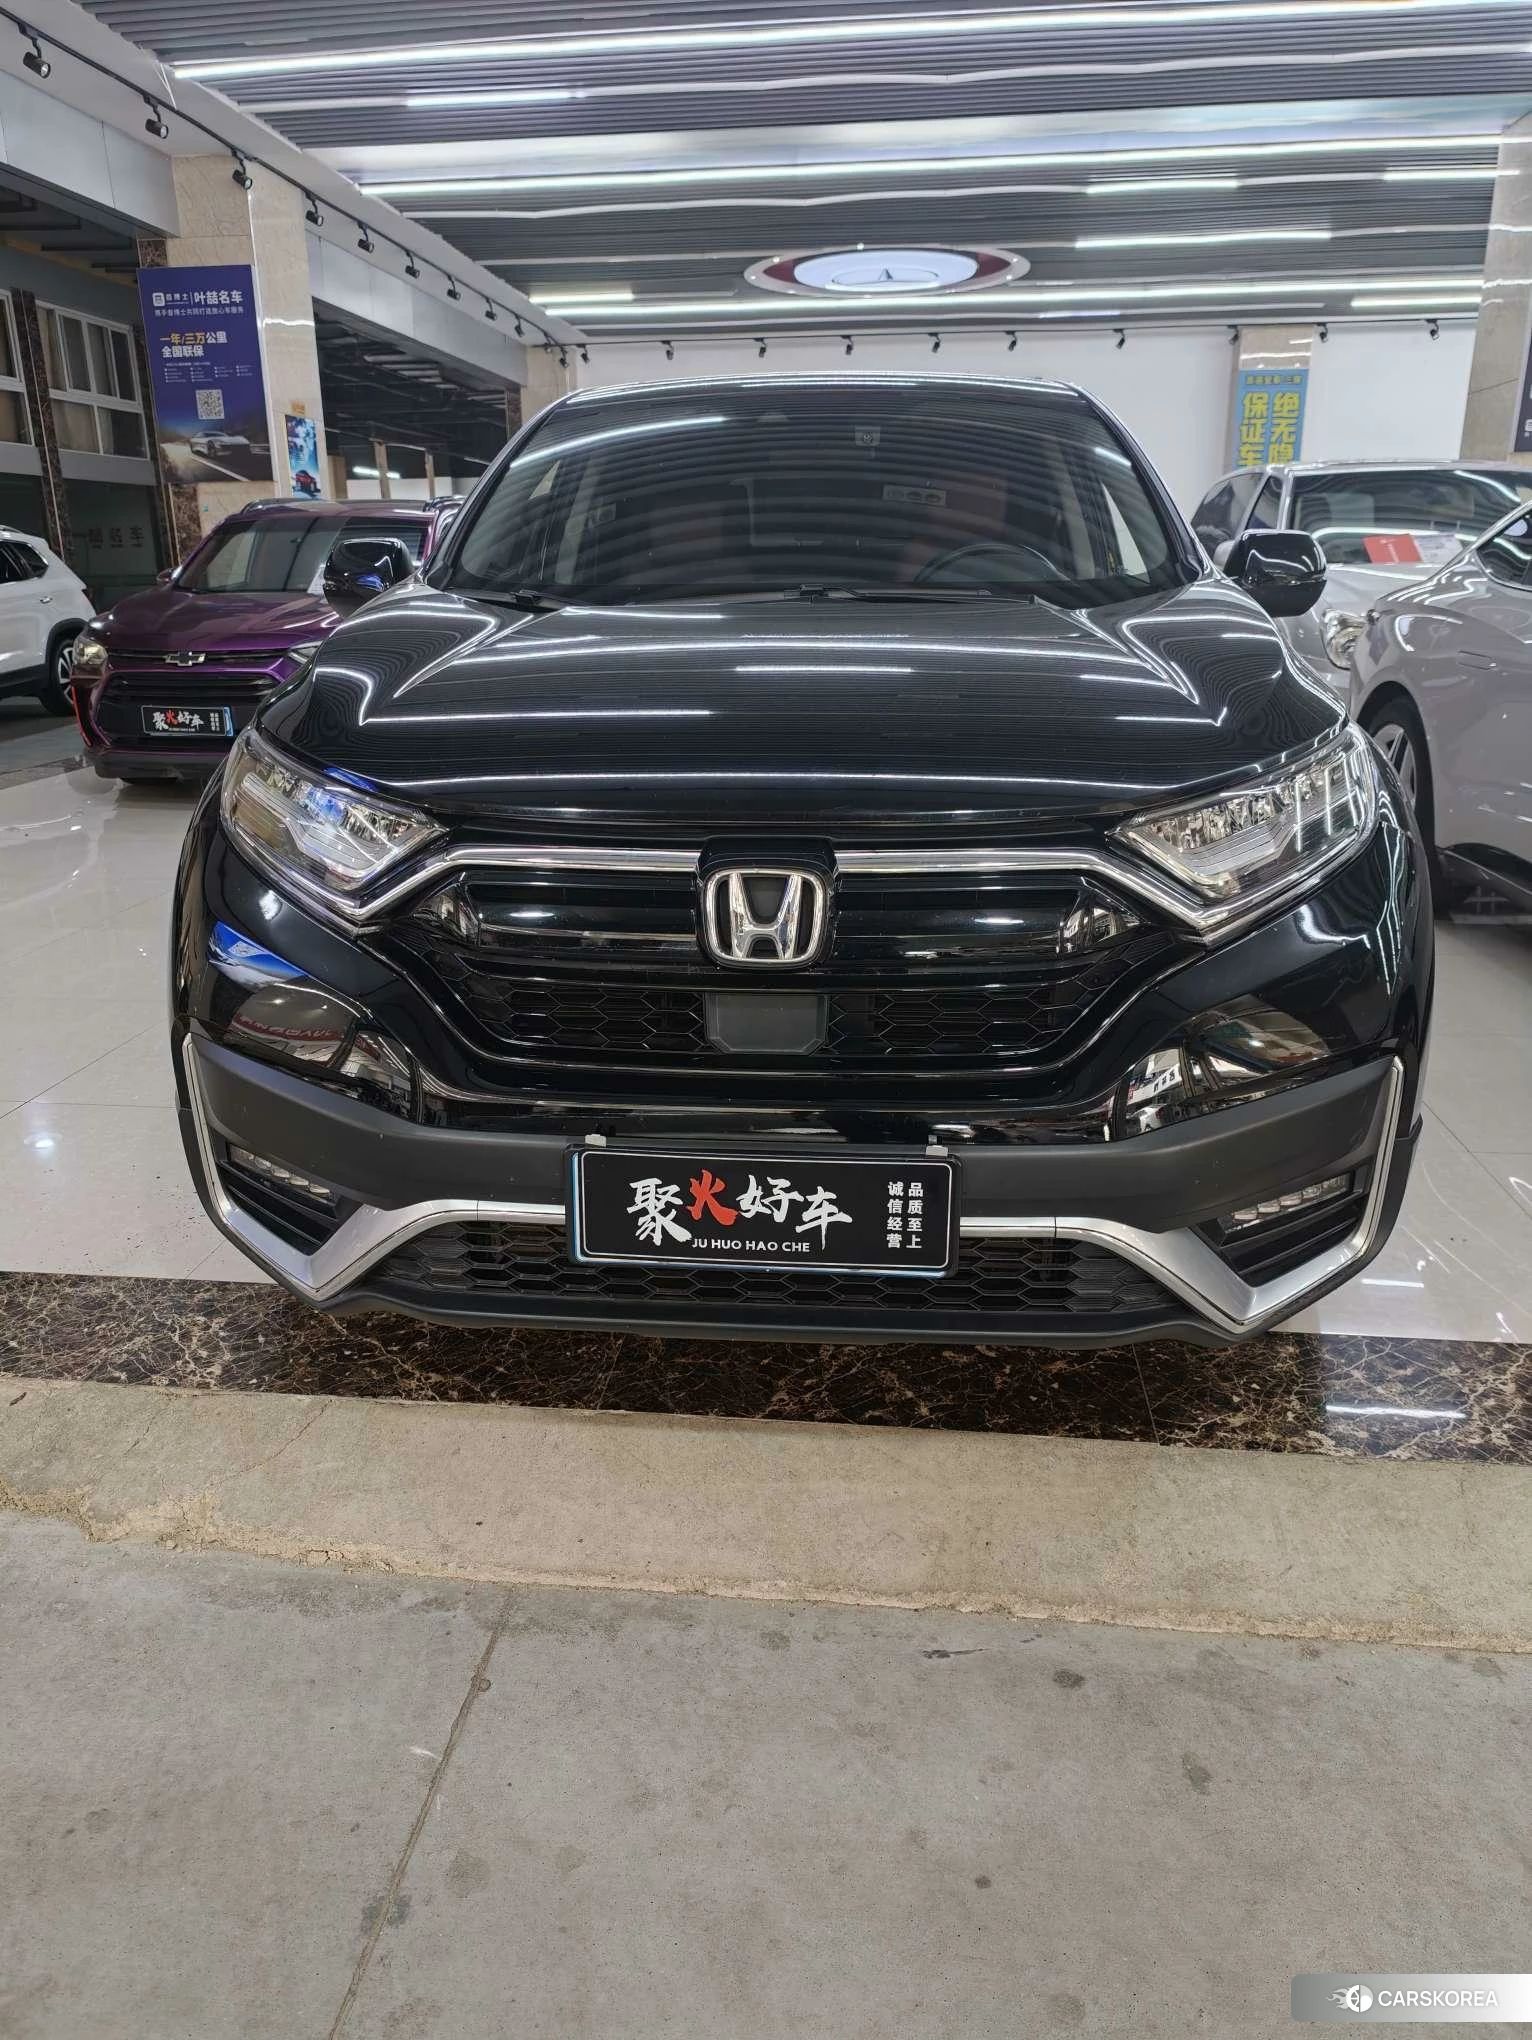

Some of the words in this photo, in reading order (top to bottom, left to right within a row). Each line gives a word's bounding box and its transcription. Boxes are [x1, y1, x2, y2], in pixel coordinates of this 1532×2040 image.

[193, 290, 243, 304] 叶喆名车
[160, 331, 227, 344] 一年/三万公里
[161, 345, 204, 358] 全国联保
[152, 709, 203, 730] 聚火好车
[626, 1168, 853, 1250] 聚火好车
[886, 1181, 904, 1249] 诚信经营
[907, 1182, 924, 1249] 品质至上
[692, 1238, 708, 1249] JU
[711, 1239, 741, 1250] HUO
[745, 1239, 778, 1252] HAO
[782, 1241, 810, 1253] CHE
